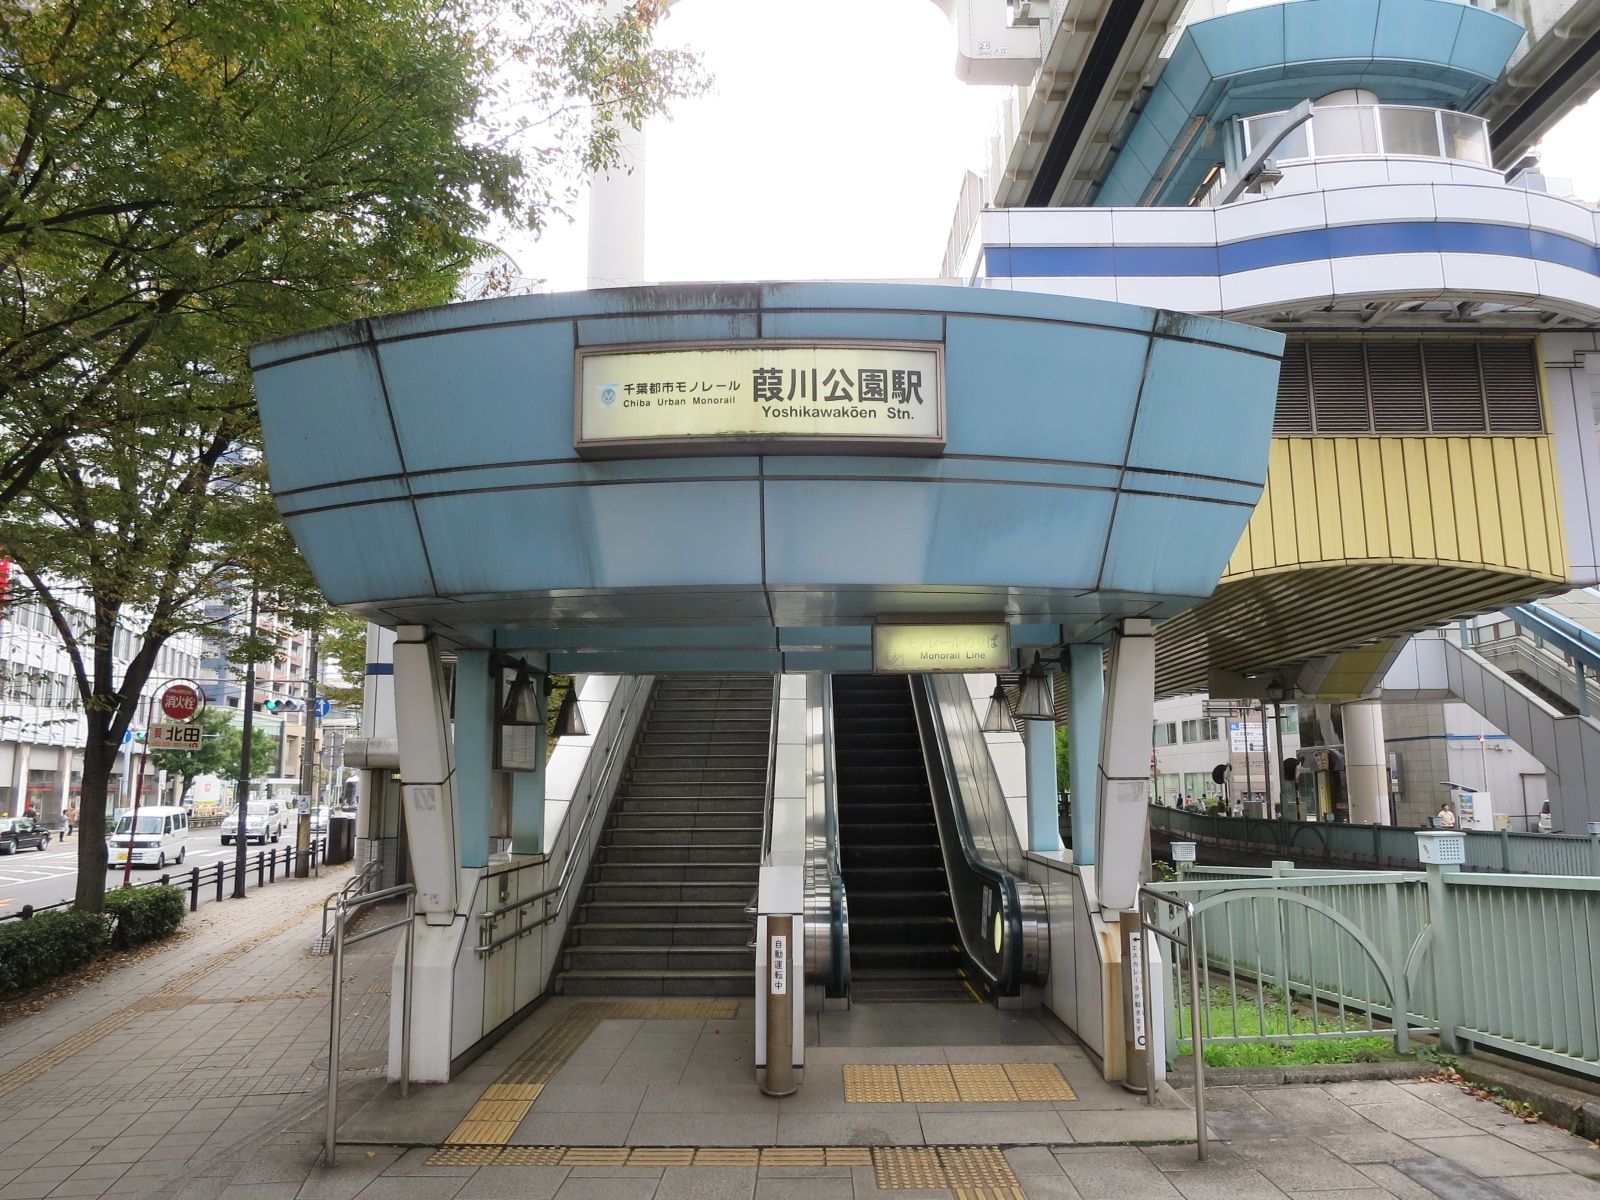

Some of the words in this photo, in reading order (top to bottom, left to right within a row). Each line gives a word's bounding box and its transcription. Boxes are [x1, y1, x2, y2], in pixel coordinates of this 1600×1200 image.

[623, 380, 741, 395] 千葉都市モノレール
[752, 367, 924, 405] 葭川公園駅
[623, 399, 651, 408] Chiba
[657, 397, 686, 406] Urban
[692, 396, 736, 405] Monorail
[761, 405, 877, 419] Yoshikawakōen
[886, 407, 915, 420] Stn.
[920, 651, 960, 660] Monorail
[966, 651, 986, 660] Line
[164, 695, 195, 710] 消火栓
[165, 726, 200, 742] 北田
[774, 940, 784, 991] 自動運転中
